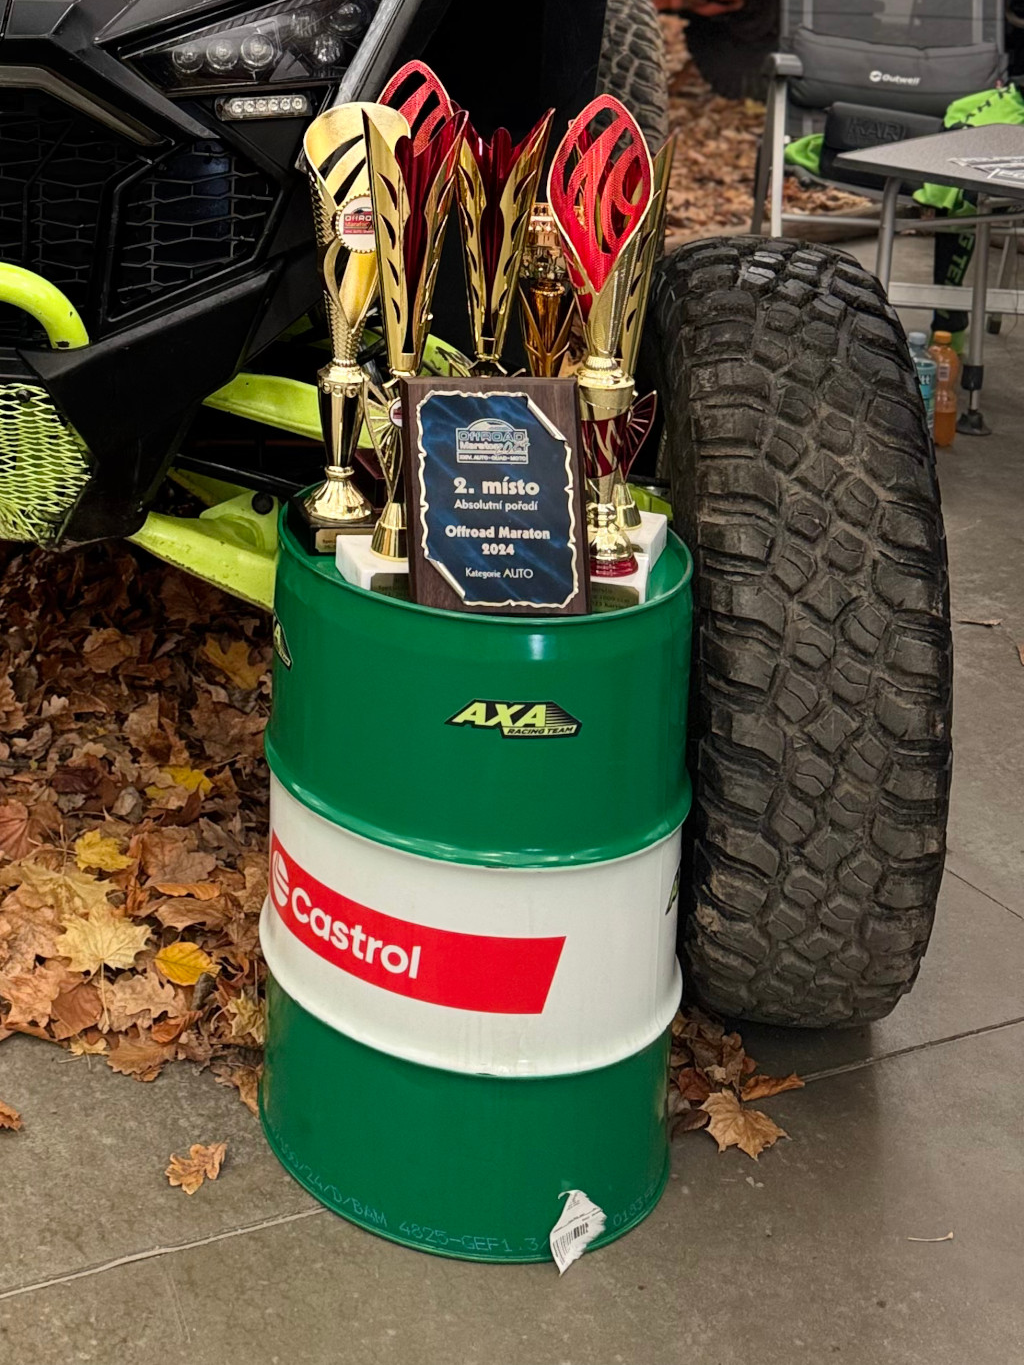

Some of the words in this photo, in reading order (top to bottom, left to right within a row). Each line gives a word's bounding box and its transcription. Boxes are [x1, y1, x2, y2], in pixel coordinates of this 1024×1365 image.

[882, 73, 921, 86] Outwell
[453, 477, 475, 495] 2.
[482, 476, 540, 496] místo
[453, 499, 503, 510] Absolutní
[505, 500, 539, 513] pořadí
[445, 525, 495, 539] Offroad
[498, 526, 551, 540] Maraton
[481, 543, 516, 556] 2024
[465, 567, 502, 579] Kategorie
[502, 568, 534, 580] AUTO
[451, 701, 547, 728] AXA
[547, 727, 574, 735] TEAM
[291, 886, 422, 980] Castrol
